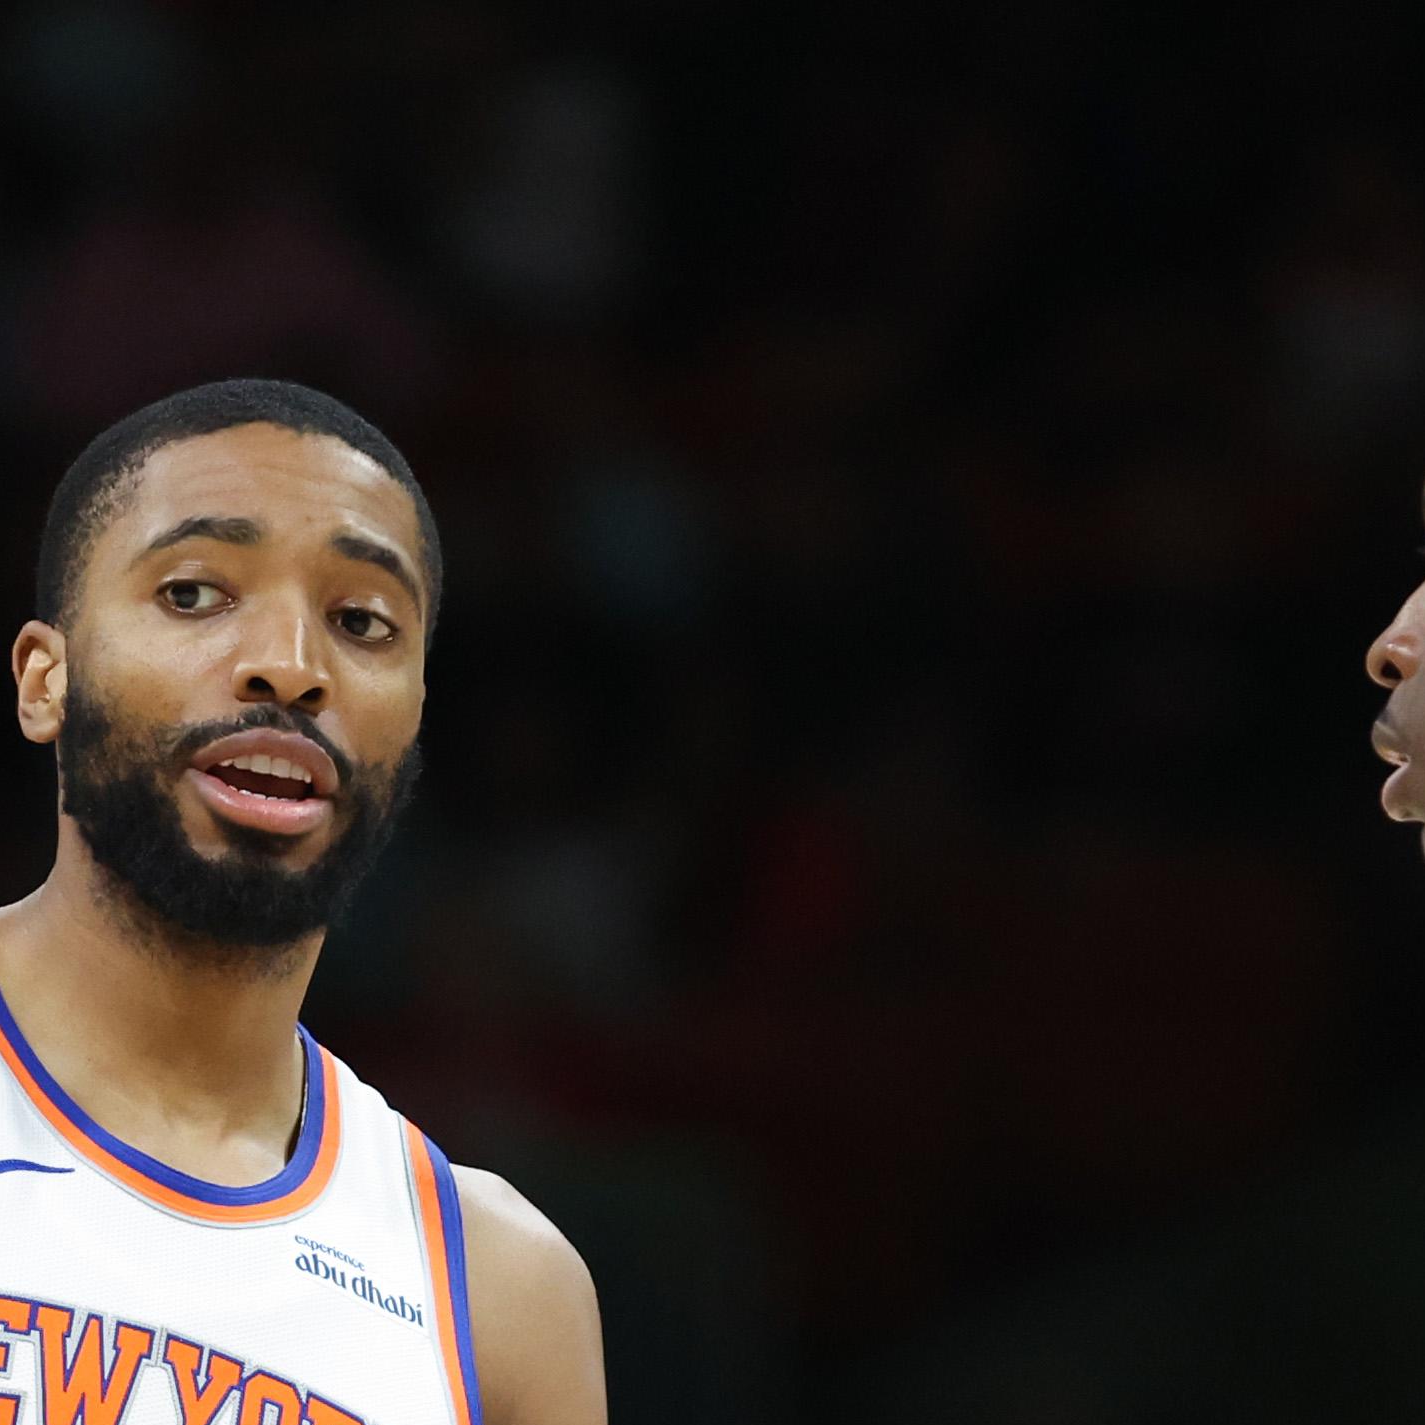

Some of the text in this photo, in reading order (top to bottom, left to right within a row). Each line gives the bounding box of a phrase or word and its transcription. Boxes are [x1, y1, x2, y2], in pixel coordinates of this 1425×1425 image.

[294, 1234, 365, 1271] experience
[295, 1252, 423, 1327] abu dhabi
